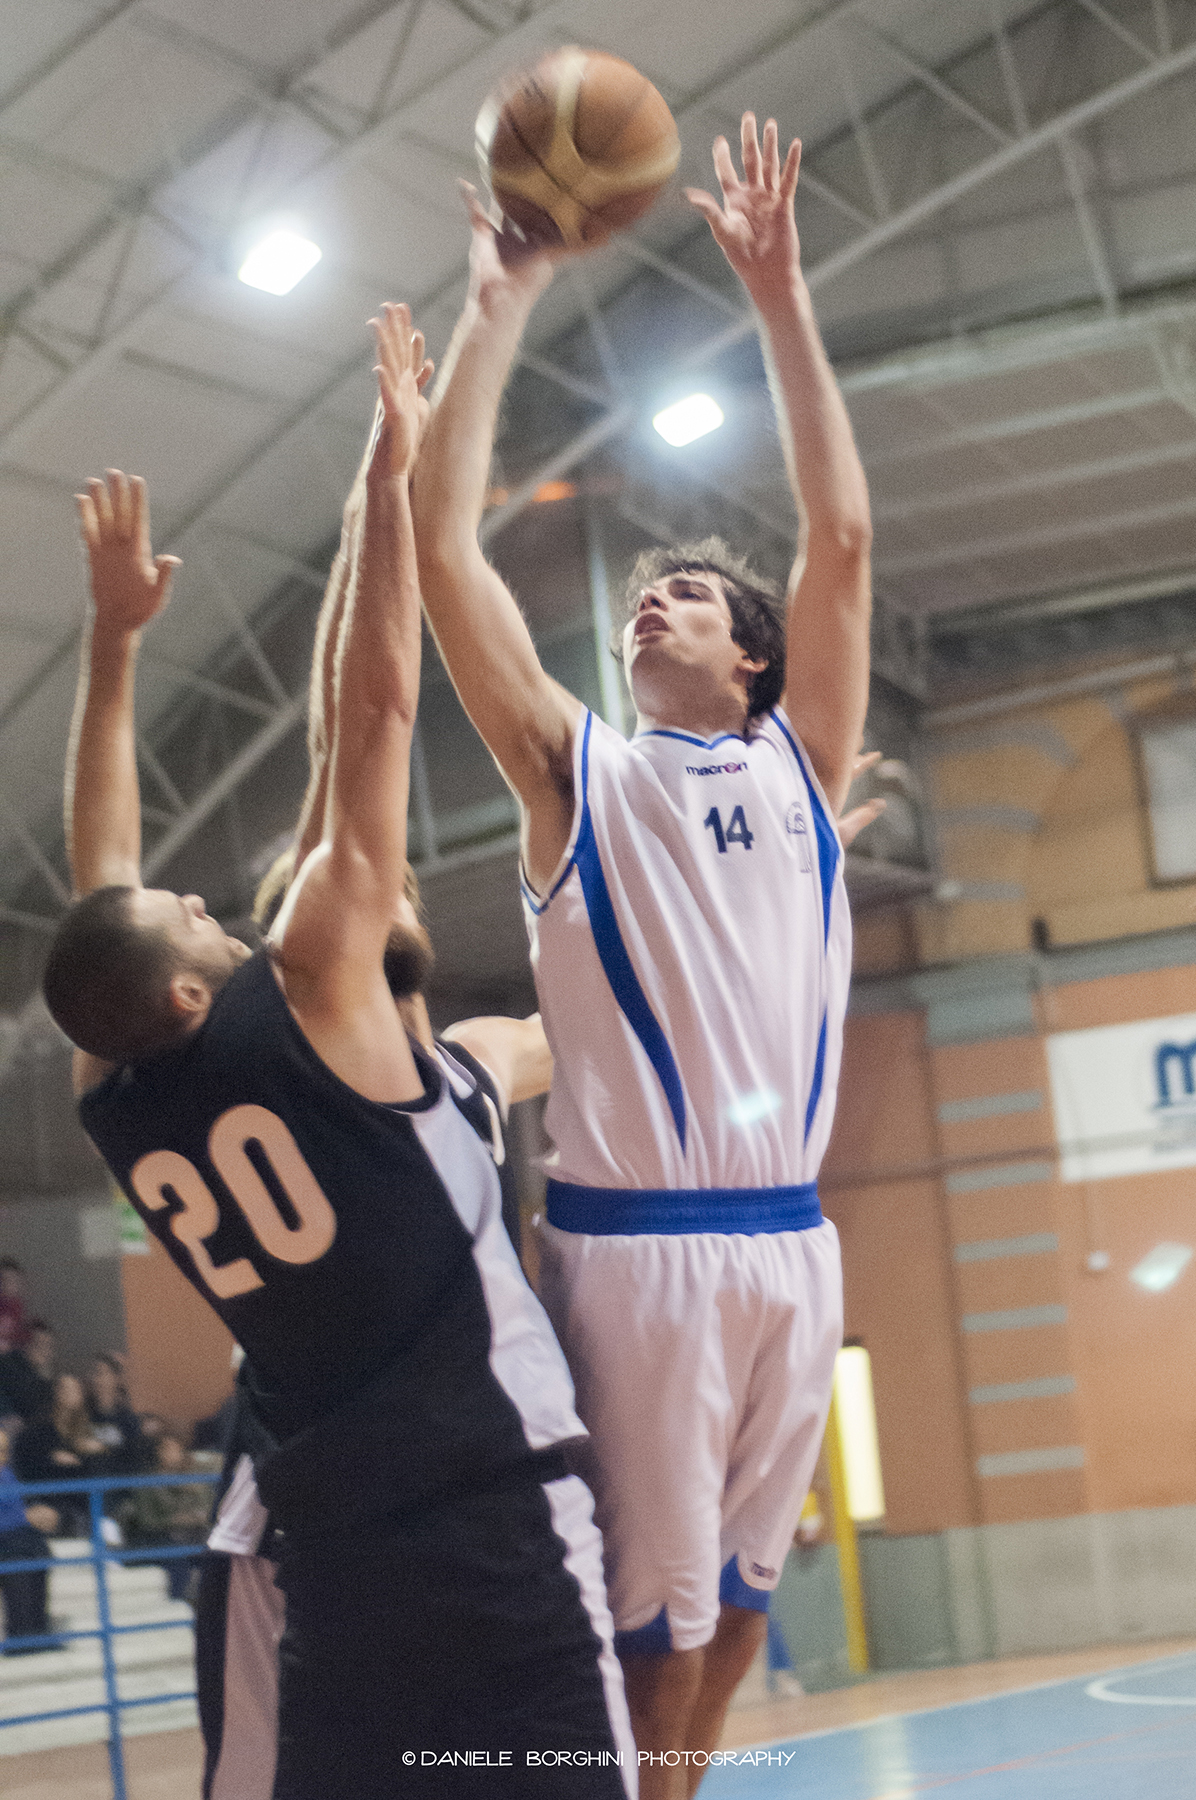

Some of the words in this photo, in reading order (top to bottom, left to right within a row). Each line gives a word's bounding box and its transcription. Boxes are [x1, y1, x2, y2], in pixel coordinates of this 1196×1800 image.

[685, 761, 749, 777] macron
[703, 804, 755, 854] 14
[130, 1103, 338, 1300] 20
